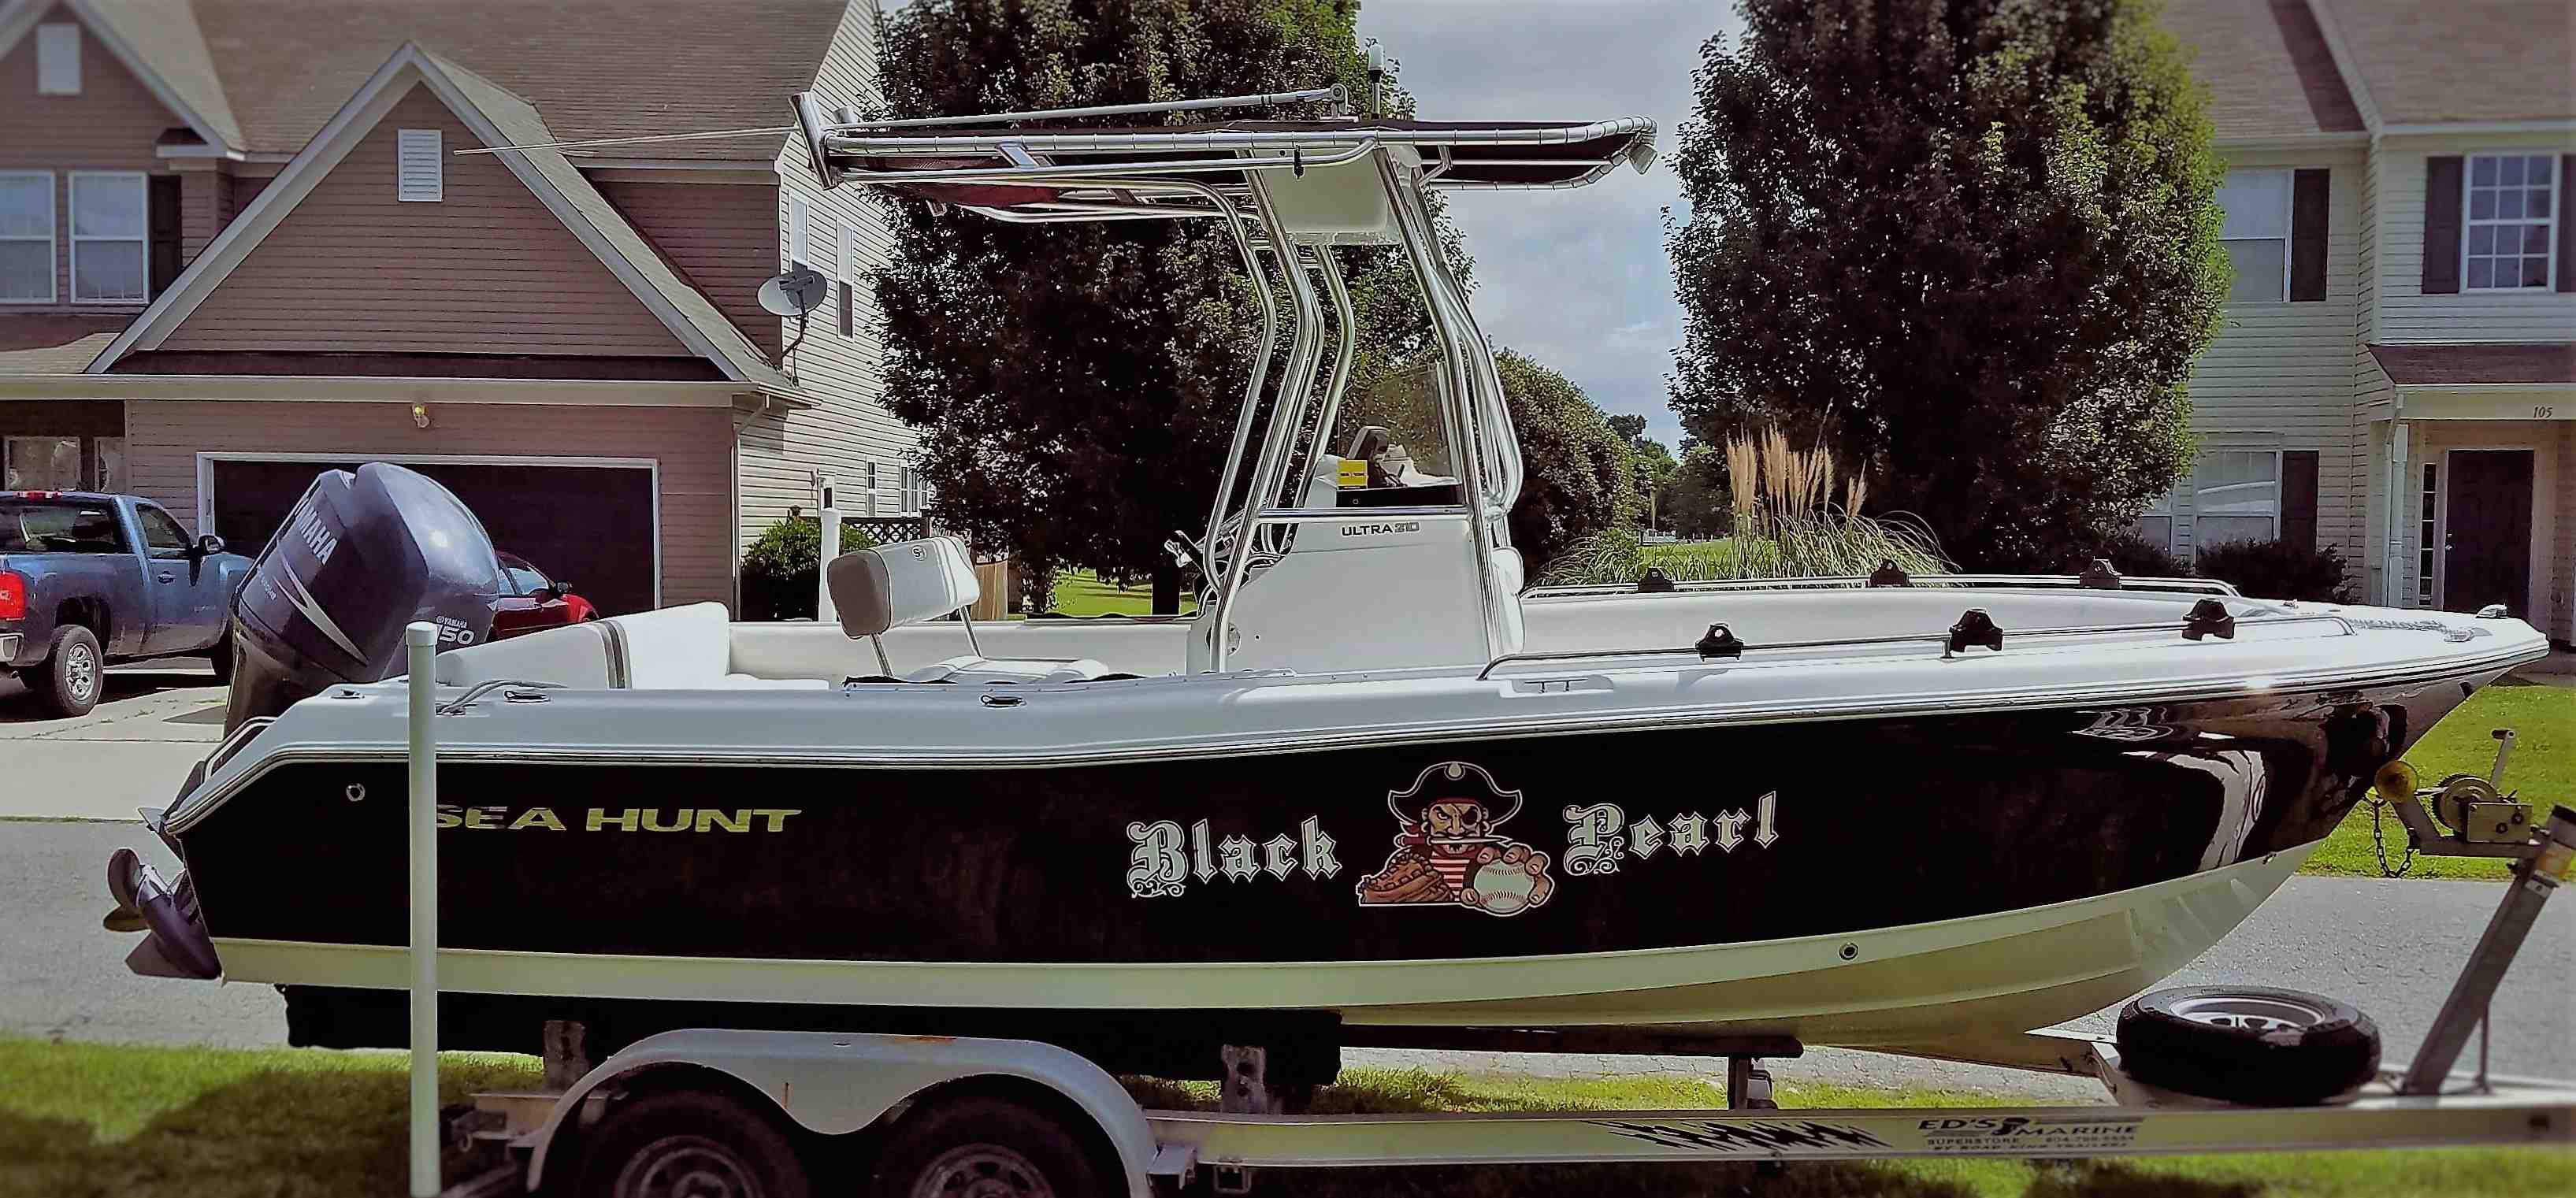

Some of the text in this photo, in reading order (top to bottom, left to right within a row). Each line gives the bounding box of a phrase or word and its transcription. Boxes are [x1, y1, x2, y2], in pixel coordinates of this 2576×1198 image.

[2533, 406, 2553, 418] 105
[1342, 524, 1393, 536] ULTRA
[585, 807, 802, 833] HUNT
[1127, 790, 1779, 898] Black Pearl
[1917, 1118, 1998, 1130] ED'S
[2015, 1126, 2138, 1135] MARINE
